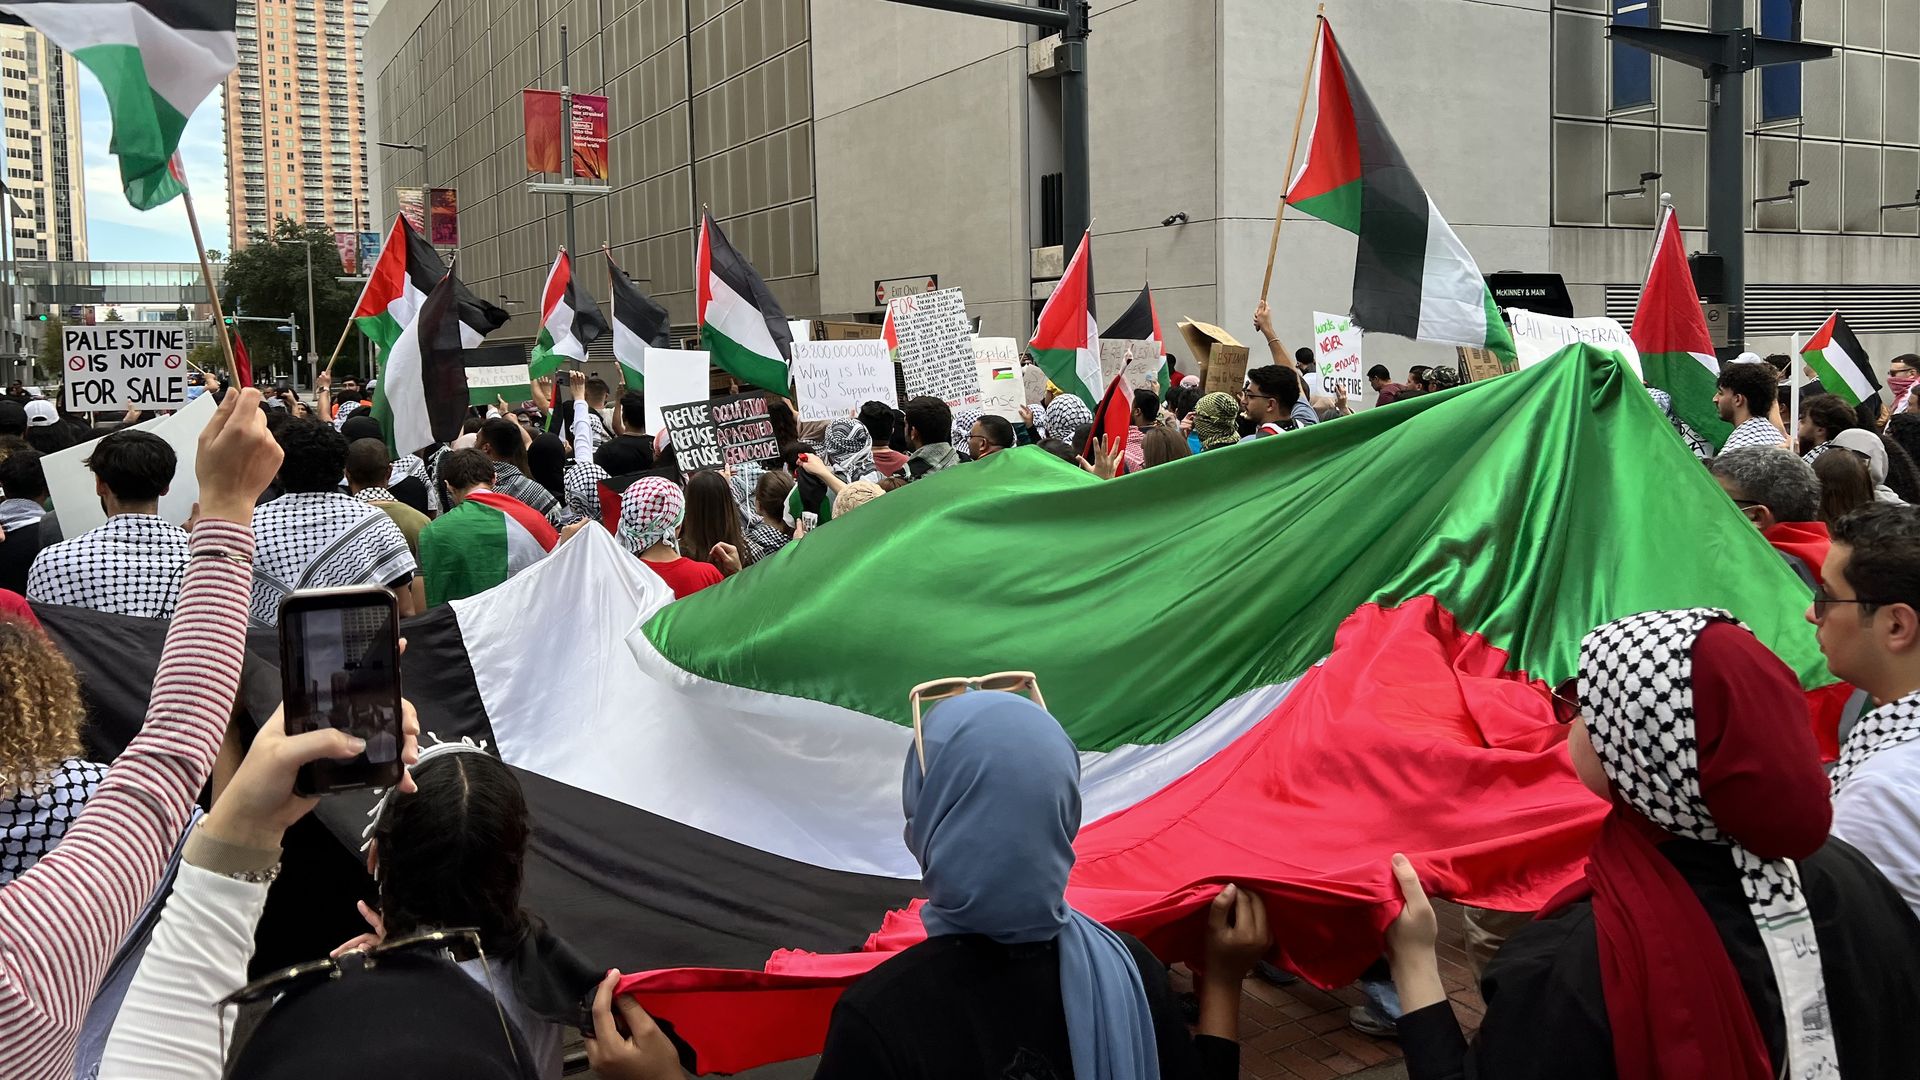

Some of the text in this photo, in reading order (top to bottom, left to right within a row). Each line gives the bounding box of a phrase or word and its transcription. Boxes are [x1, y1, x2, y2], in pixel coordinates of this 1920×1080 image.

[1531, 288, 1546, 296] MAIN
[890, 296, 917, 314] FOR
[65, 329, 183, 351] PALESTINE
[1319, 335, 1343, 354] NEVER
[87, 352, 161, 372] IS NOT
[1318, 353, 1360, 376] be enough
[798, 362, 830, 387] Why
[71, 376, 183, 407] FOR SALE
[807, 383, 828, 399] US
[1347, 378, 1362, 395] FIRE
[664, 404, 710, 429] REFUSE
[670, 426, 717, 451] REFUSE
[676, 440, 778, 471] REFUSE GENOCIDE
